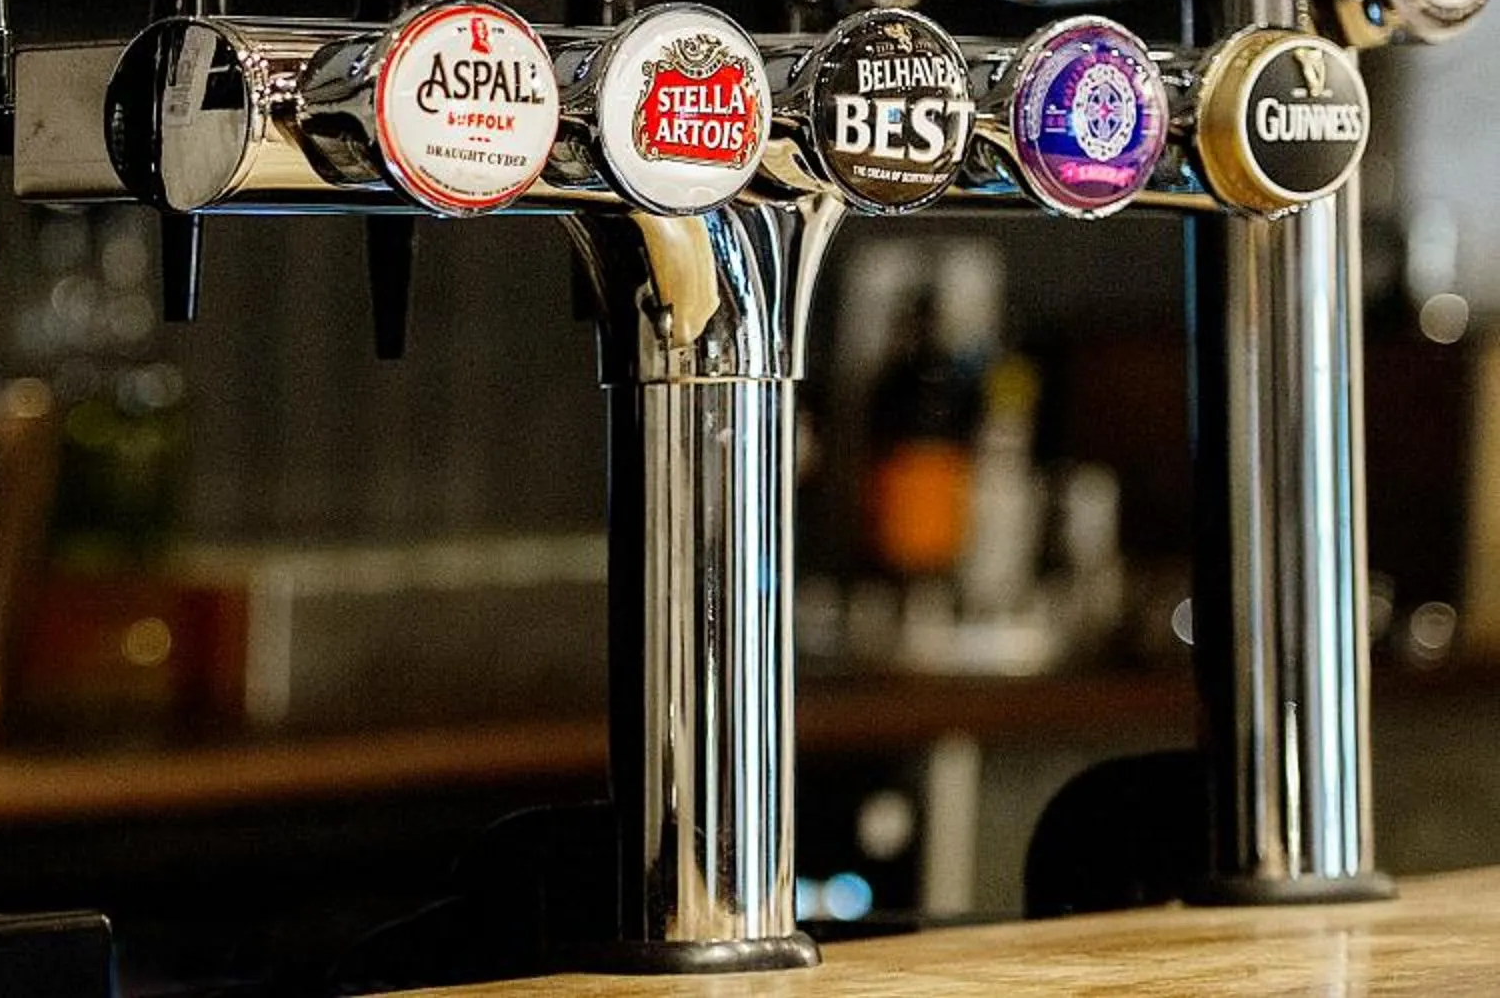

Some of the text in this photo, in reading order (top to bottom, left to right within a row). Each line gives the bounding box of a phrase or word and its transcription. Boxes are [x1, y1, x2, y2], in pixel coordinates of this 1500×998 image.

[416, 51, 546, 115] ASPALL
[857, 53, 966, 94] BELHAVEN
[657, 85, 746, 115] STELLA
[447, 110, 516, 132] SUFFOLK
[654, 117, 745, 151] ARTOIS
[833, 93, 976, 163] BEST
[1256, 97, 1362, 142] GUINNESS
[425, 144, 487, 163] DRAUGHT
